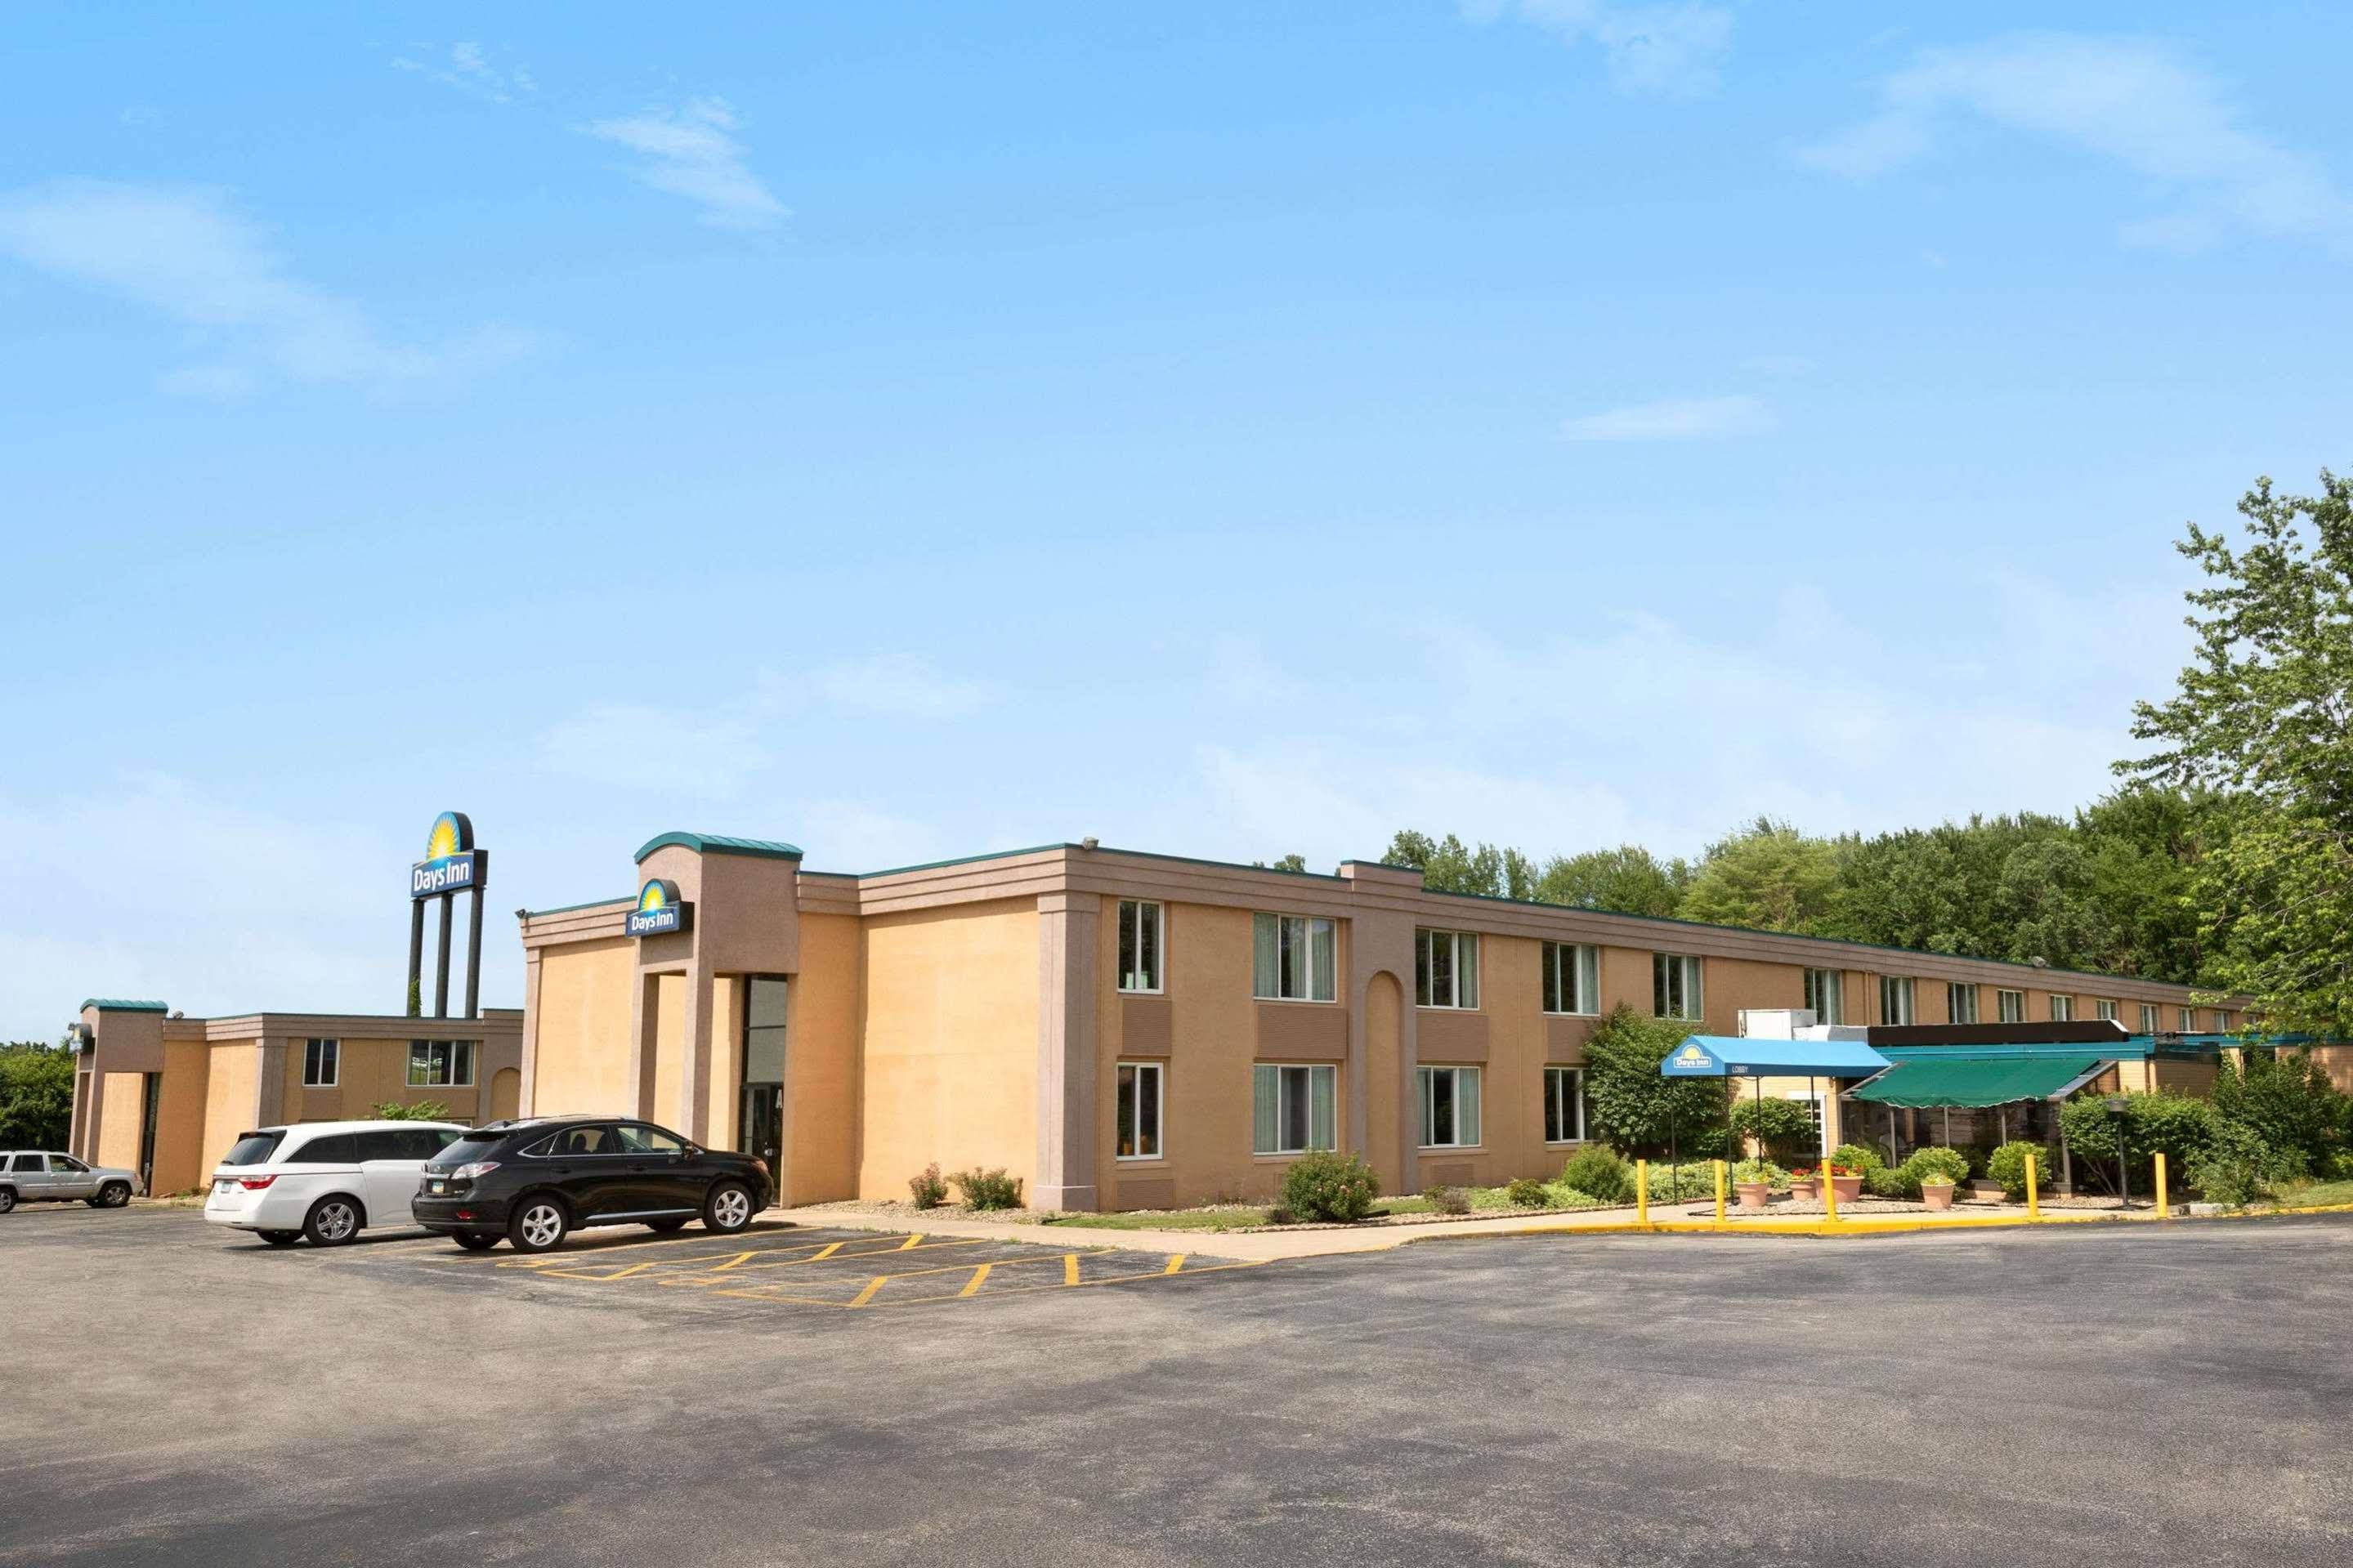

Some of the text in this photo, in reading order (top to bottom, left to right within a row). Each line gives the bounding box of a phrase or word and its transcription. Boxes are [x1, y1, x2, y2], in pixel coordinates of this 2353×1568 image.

[414, 862, 469, 891] Days Inn
[632, 912, 673, 931] Days Inn
[1676, 1058, 1695, 1066] Days
